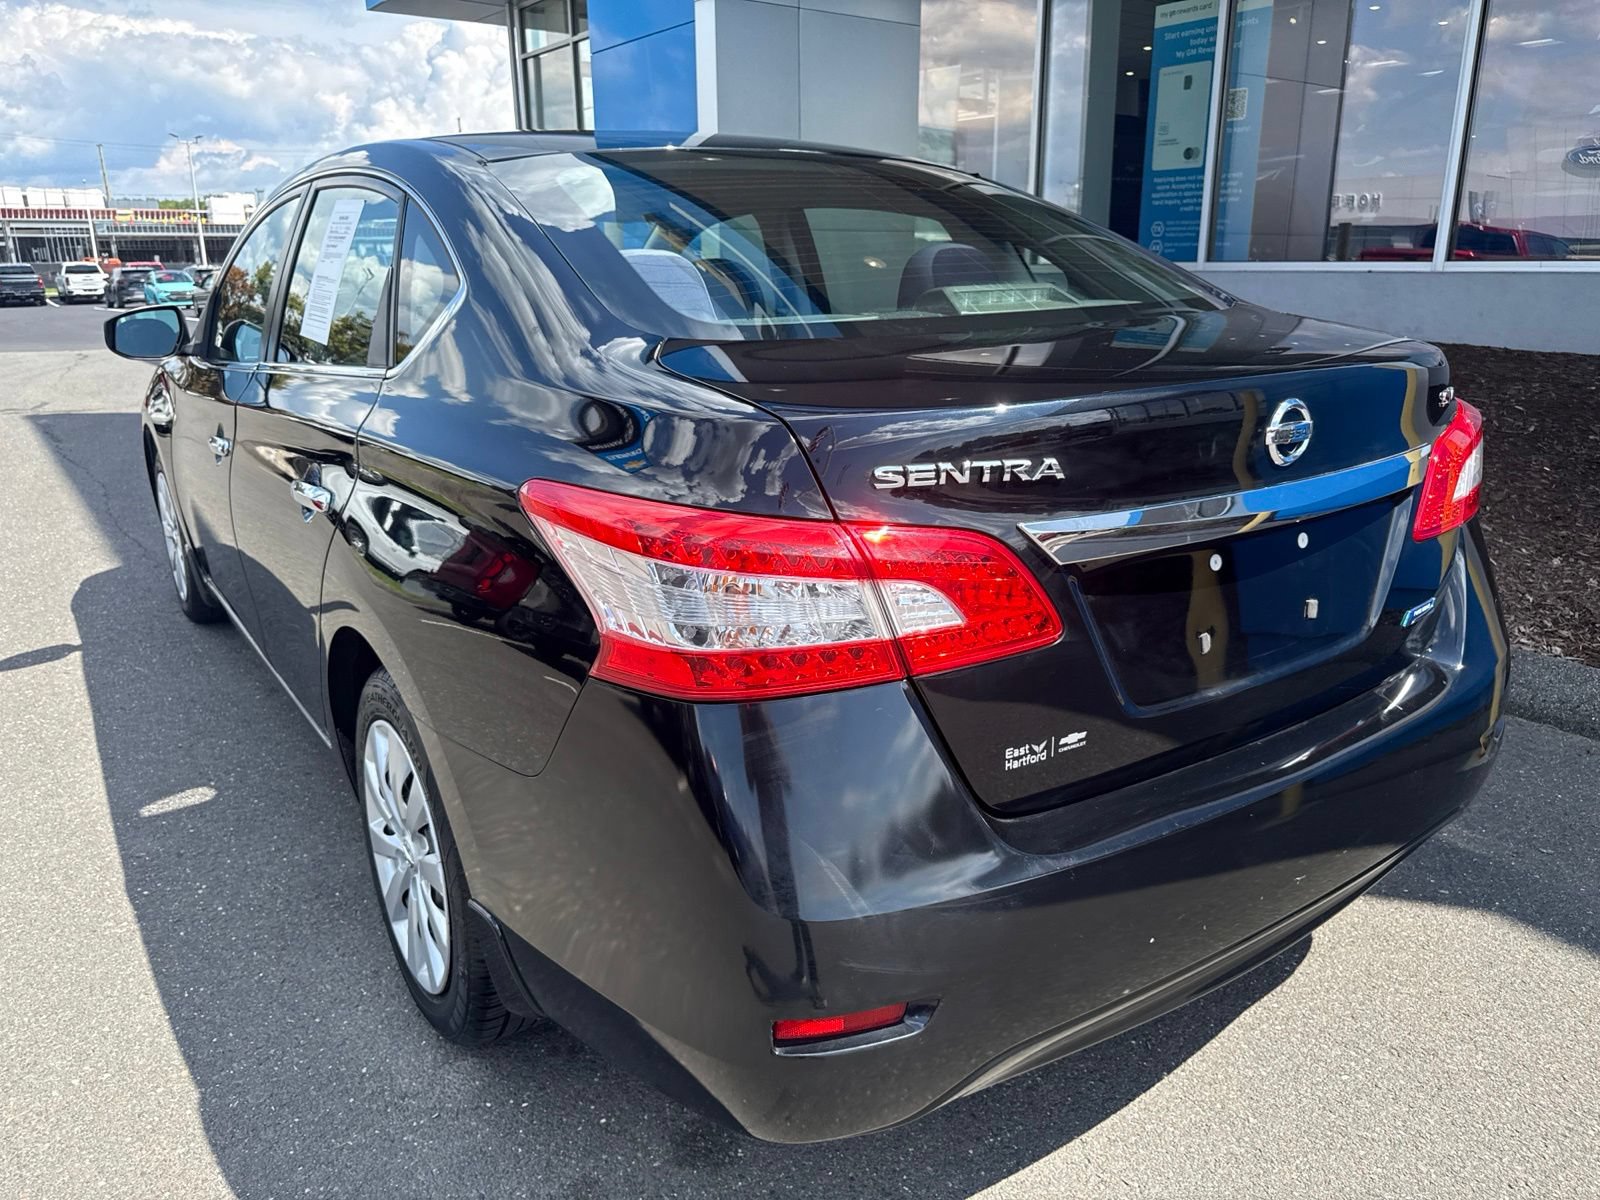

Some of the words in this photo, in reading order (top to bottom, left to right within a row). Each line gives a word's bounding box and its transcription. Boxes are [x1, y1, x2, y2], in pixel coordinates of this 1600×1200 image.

[1199, 2, 1213, 10] card
[1163, 31, 1180, 40] Start
[1181, 28, 1205, 37] earning
[1189, 37, 1208, 46] today
[1175, 50, 1185, 58] My
[1186, 48, 1197, 56] GM
[872, 457, 1067, 490] SENTRA
[1005, 743, 1030, 759] East
[1058, 740, 1087, 753] CHEVROLET
[1005, 749, 1047, 771] Hartford
